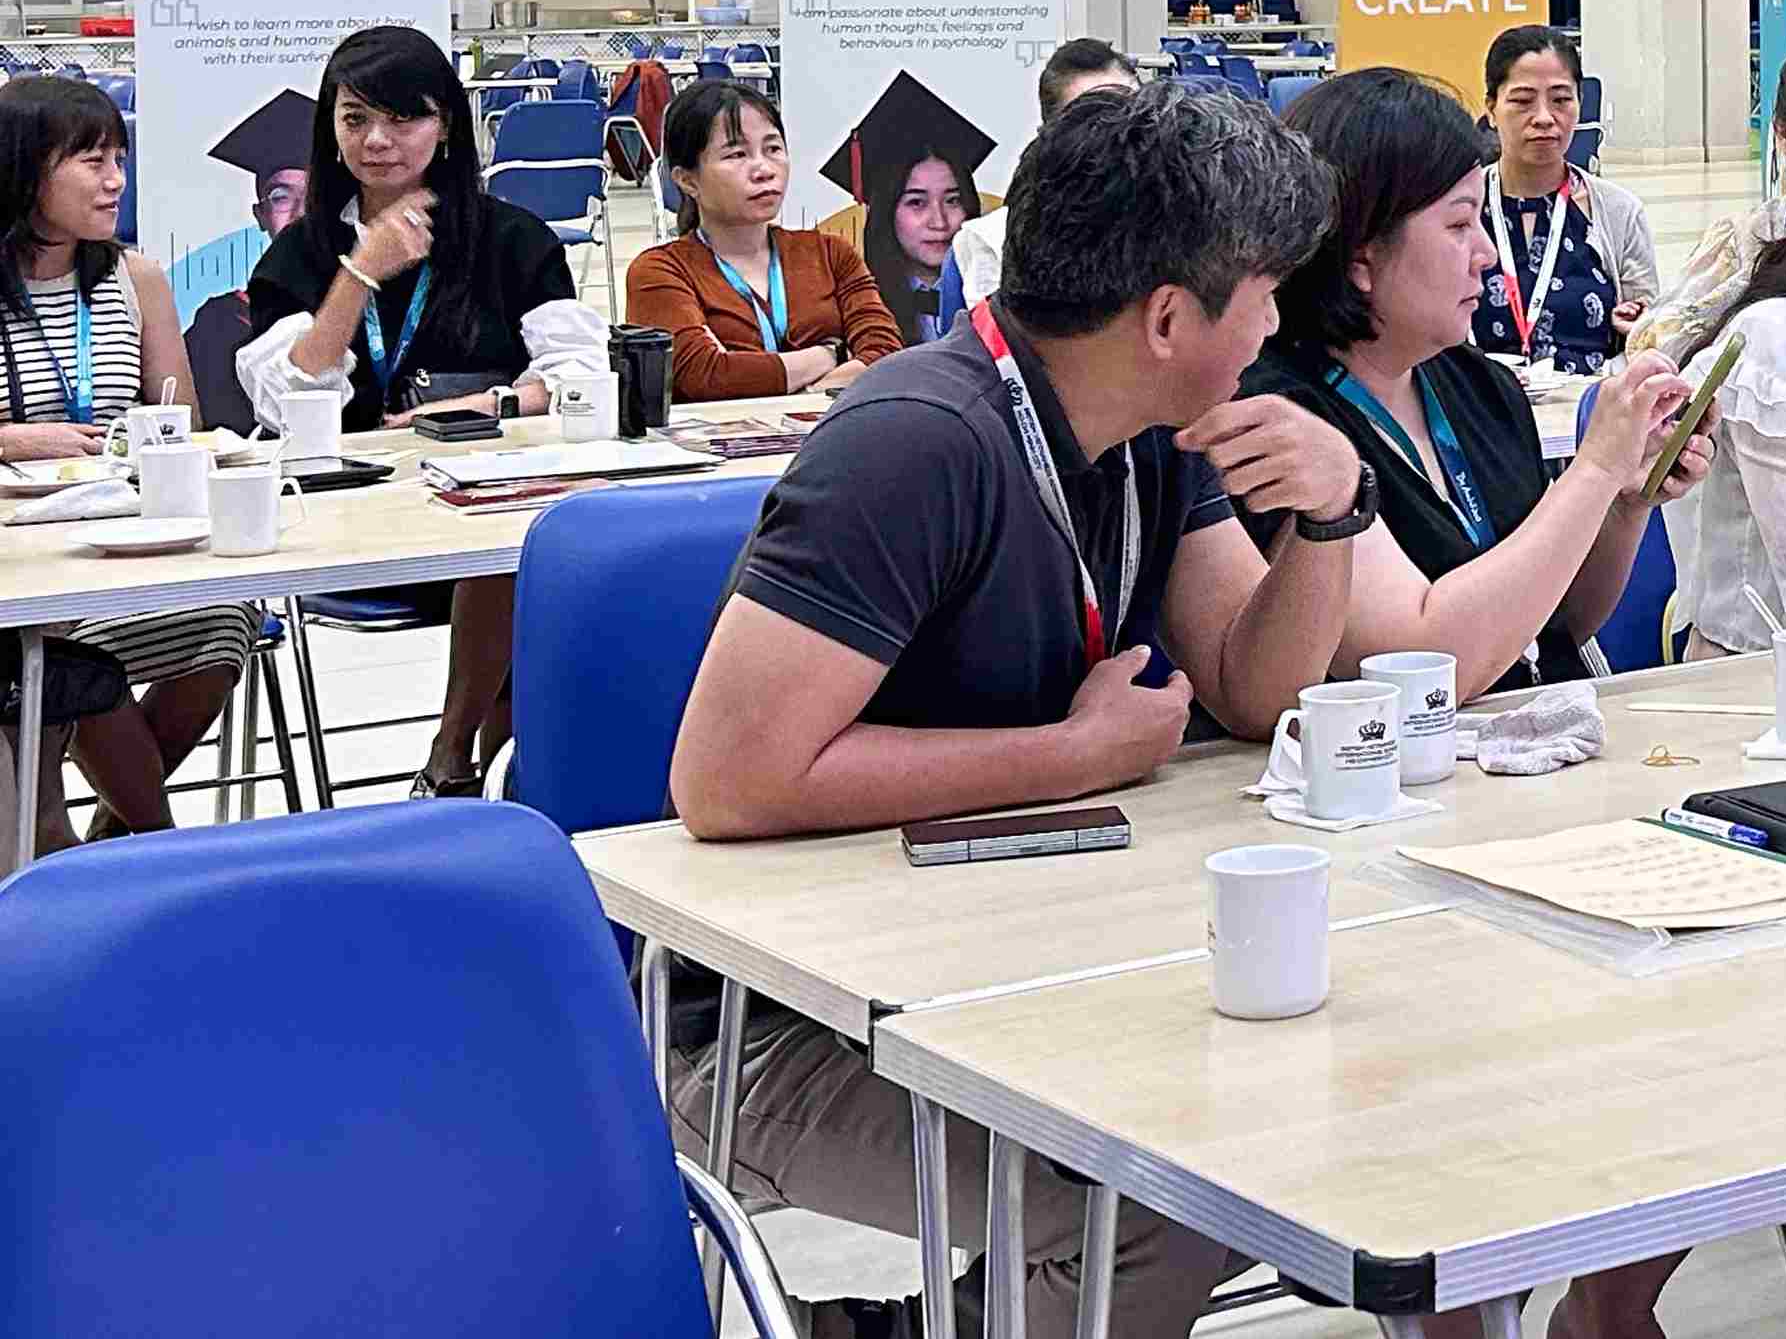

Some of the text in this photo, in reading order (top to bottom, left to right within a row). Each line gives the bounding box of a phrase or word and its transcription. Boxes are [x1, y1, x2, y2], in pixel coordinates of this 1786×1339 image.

[234, 18, 250, 30] to
[253, 17, 292, 30] learn
[295, 18, 334, 30] more
[822, 22, 871, 34] human
[996, 20, 1025, 33] and
[174, 35, 237, 49] animals
[239, 35, 270, 48] and
[203, 52, 237, 65] with
